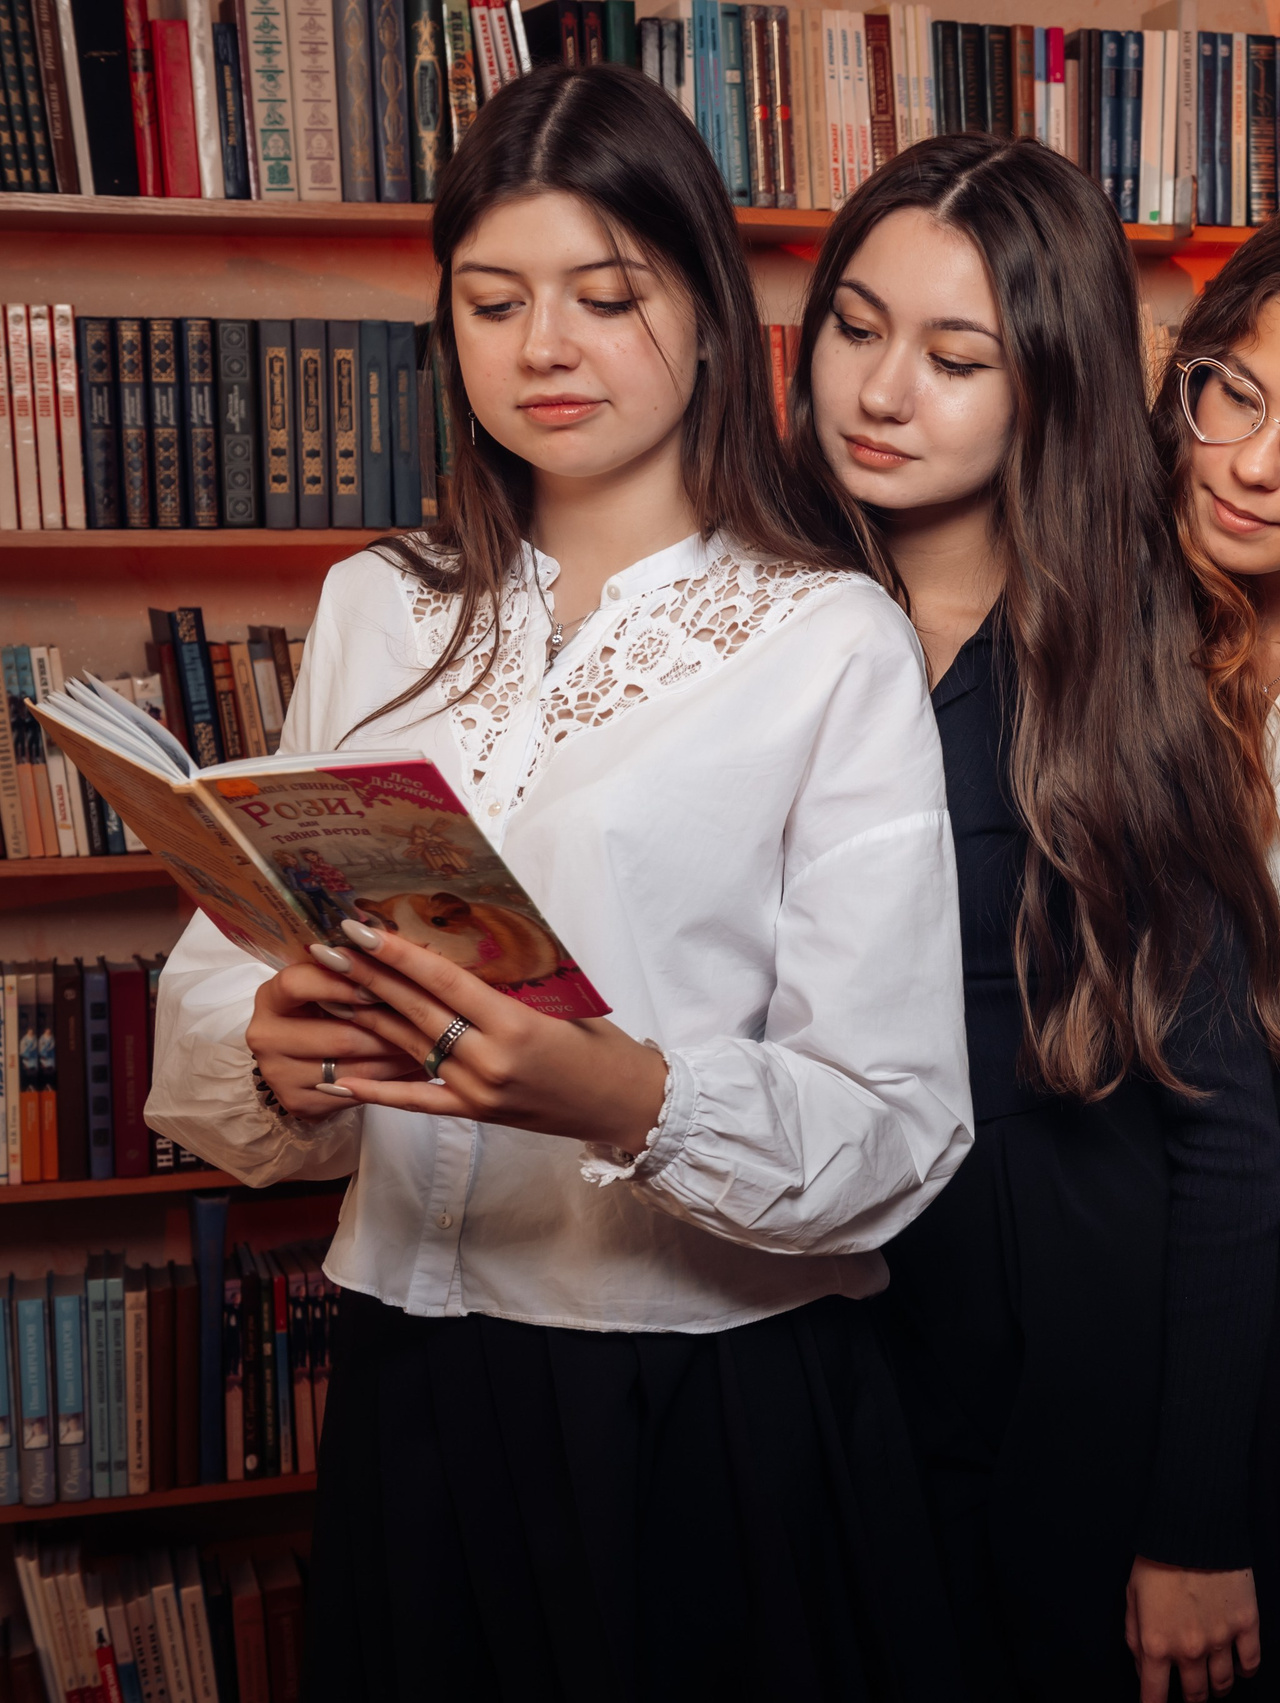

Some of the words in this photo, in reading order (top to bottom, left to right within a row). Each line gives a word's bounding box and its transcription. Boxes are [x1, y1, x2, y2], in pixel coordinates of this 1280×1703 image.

[1182, 30, 1193, 56] ДОМ
[1182, 58, 1193, 112] ЛЕДЯНОЙ
[370, 776, 444, 805] Дружбы
[388, 771, 423, 788] Лес
[271, 827, 322, 845] Тайна
[323, 825, 371, 838] ветра
[26, 1324, 39, 1384] ГОНЧАРОВ
[62, 1320, 76, 1380] ГОНЧАРОВ
[29, 1385, 40, 1410] Иван
[65, 1381, 75, 1406] Иван
[28, 1452, 47, 1498] Обрыв
[63, 1449, 83, 1493] Обрыв
